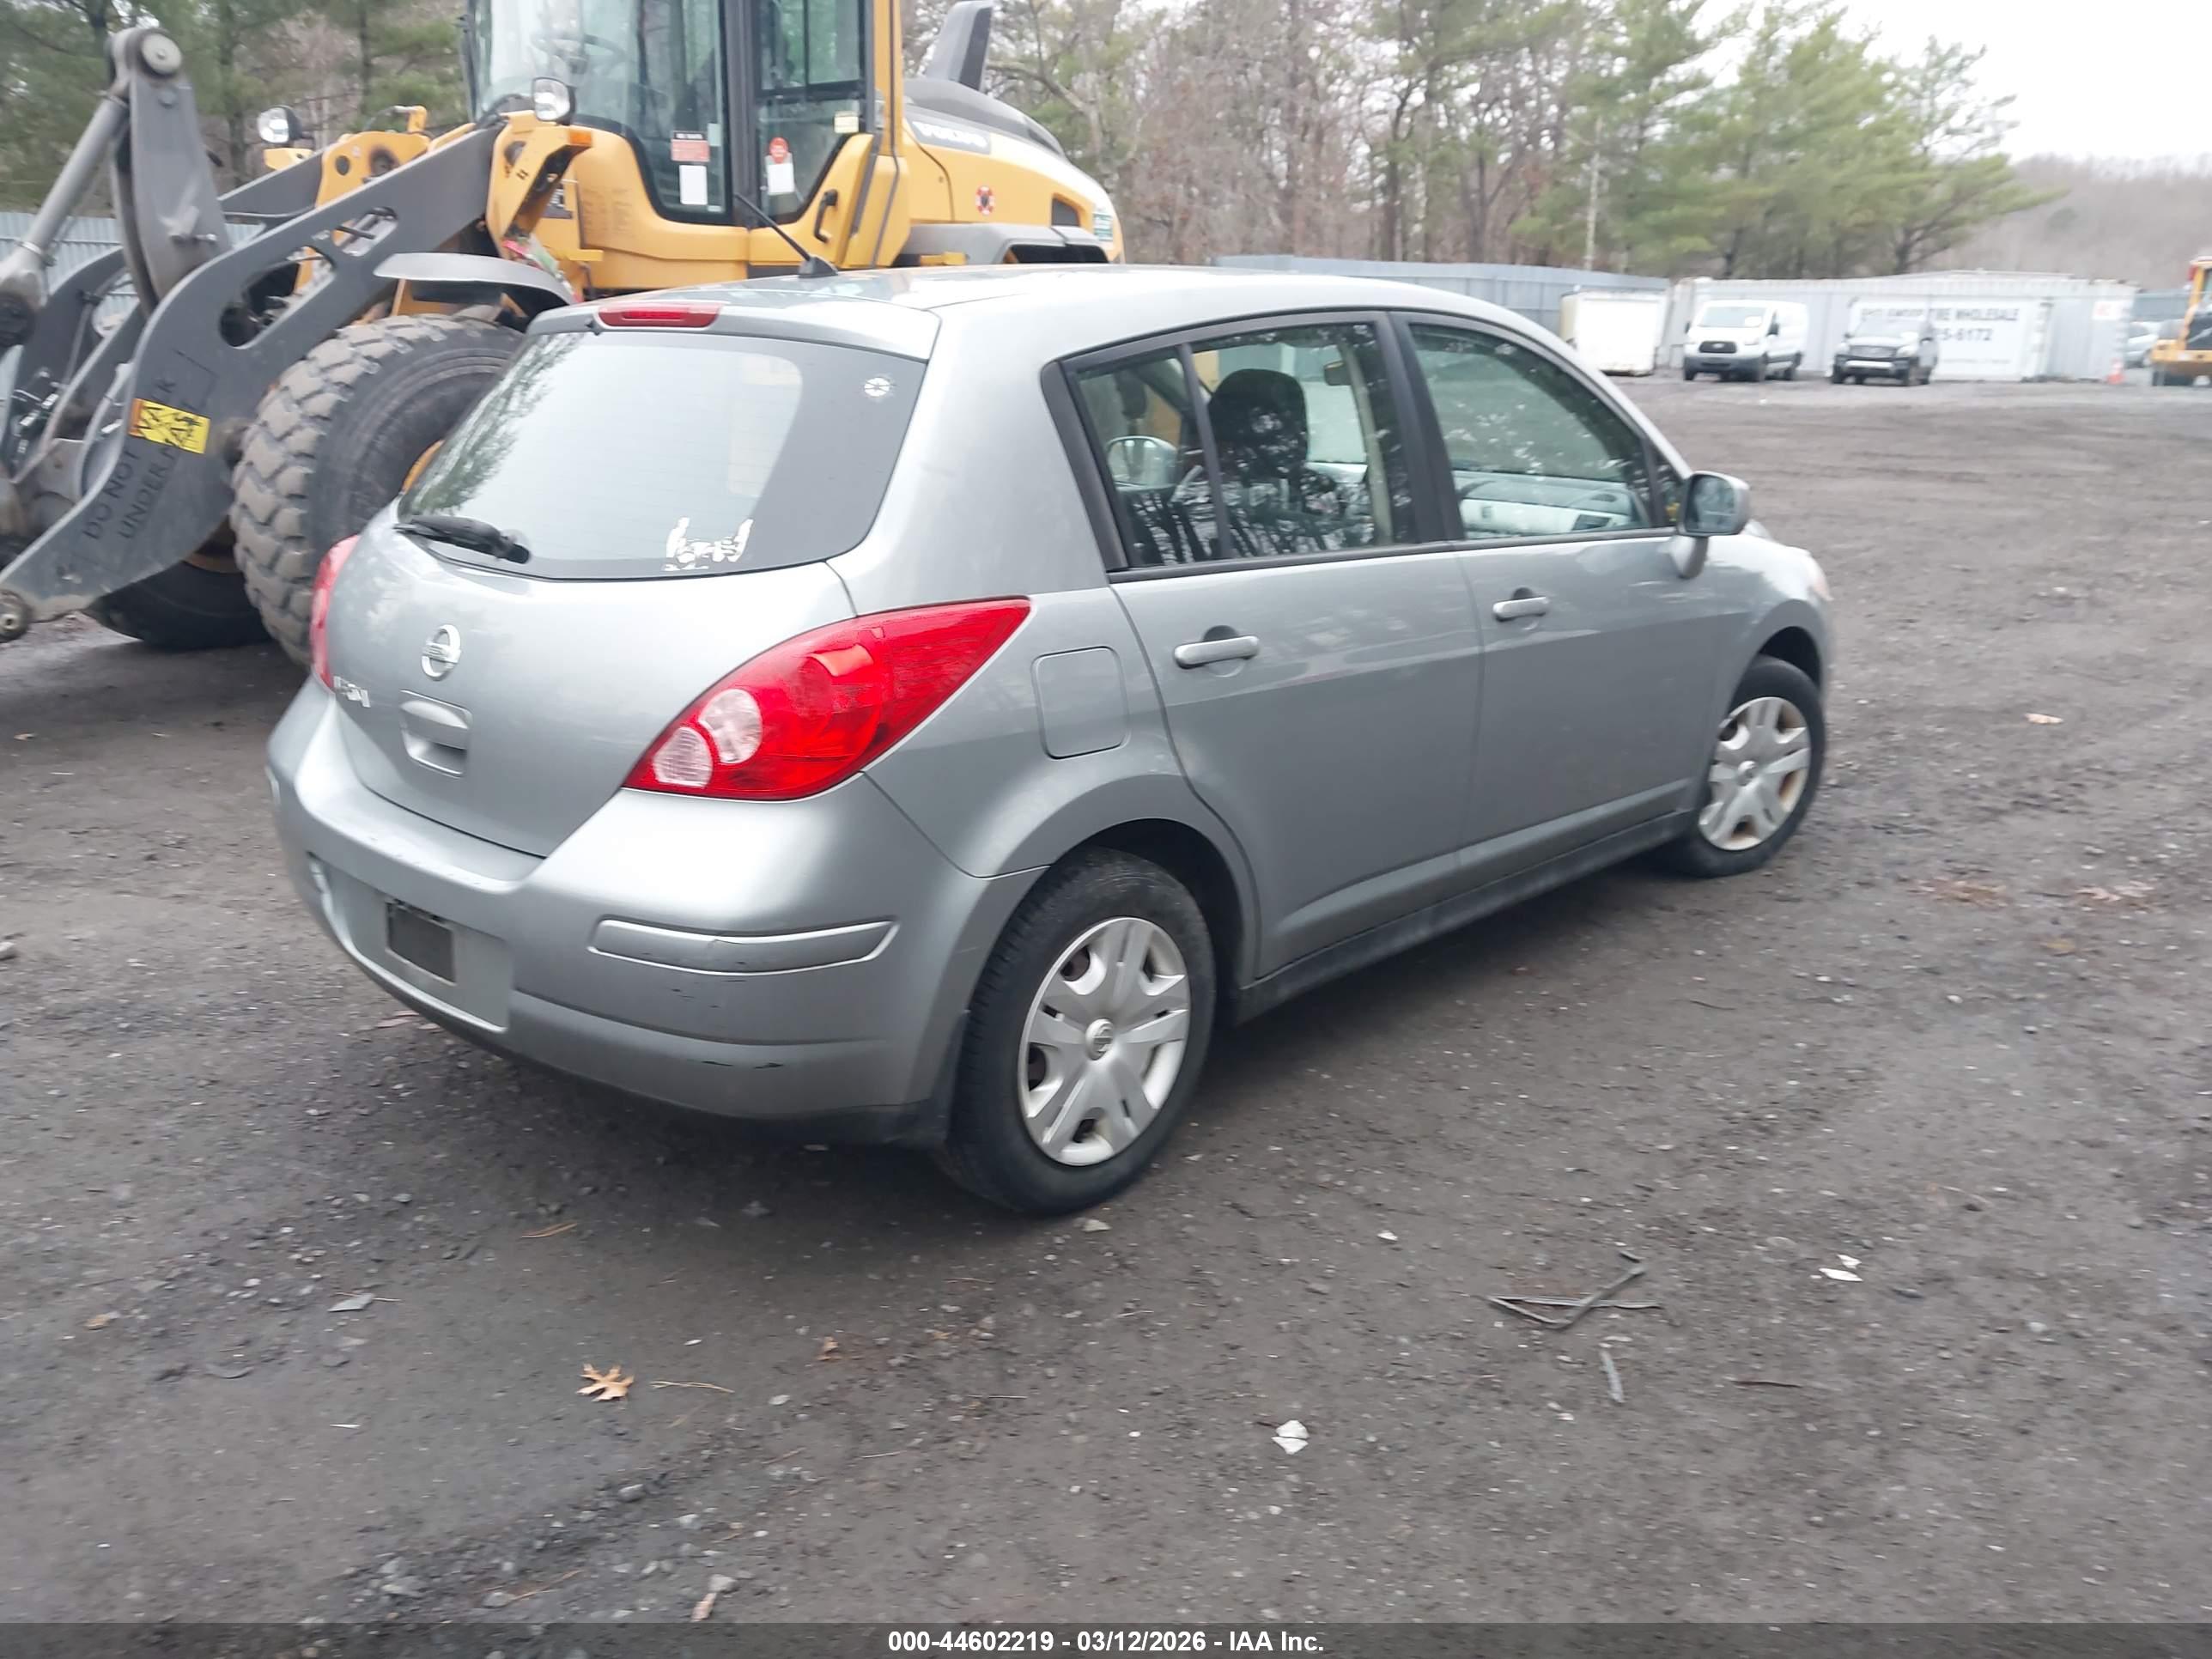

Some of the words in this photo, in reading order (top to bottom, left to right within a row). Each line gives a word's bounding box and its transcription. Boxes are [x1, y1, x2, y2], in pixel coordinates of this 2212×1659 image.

[82, 503, 114, 540] DO
[101, 449, 141, 500] NOT
[117, 463, 170, 540] UNDER
